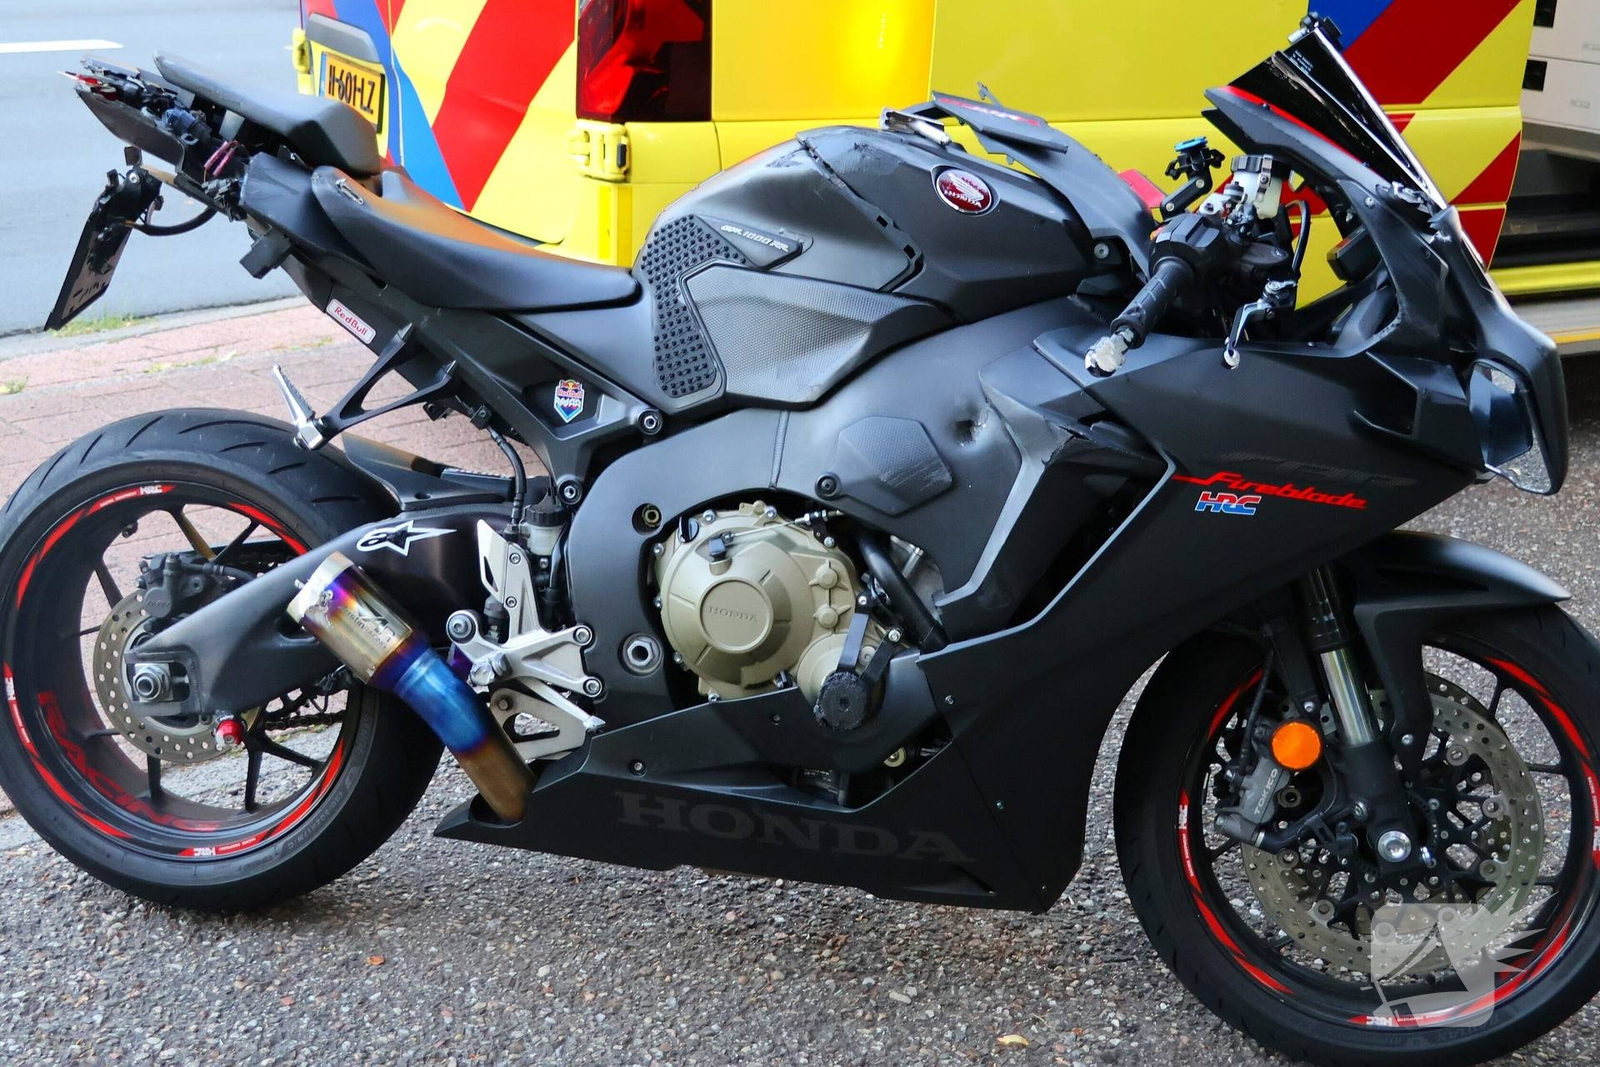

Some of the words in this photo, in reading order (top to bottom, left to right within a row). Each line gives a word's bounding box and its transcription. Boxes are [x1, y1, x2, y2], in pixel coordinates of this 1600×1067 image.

[944, 188, 983, 209] HONDA
[742, 230, 773, 245] 1000
[1171, 470, 1367, 510] Fireblade
[1194, 490, 1262, 516] HRC
[707, 606, 758, 623] HONDA
[1253, 768, 1278, 815] TOKICO
[614, 790, 976, 864] HONDA
